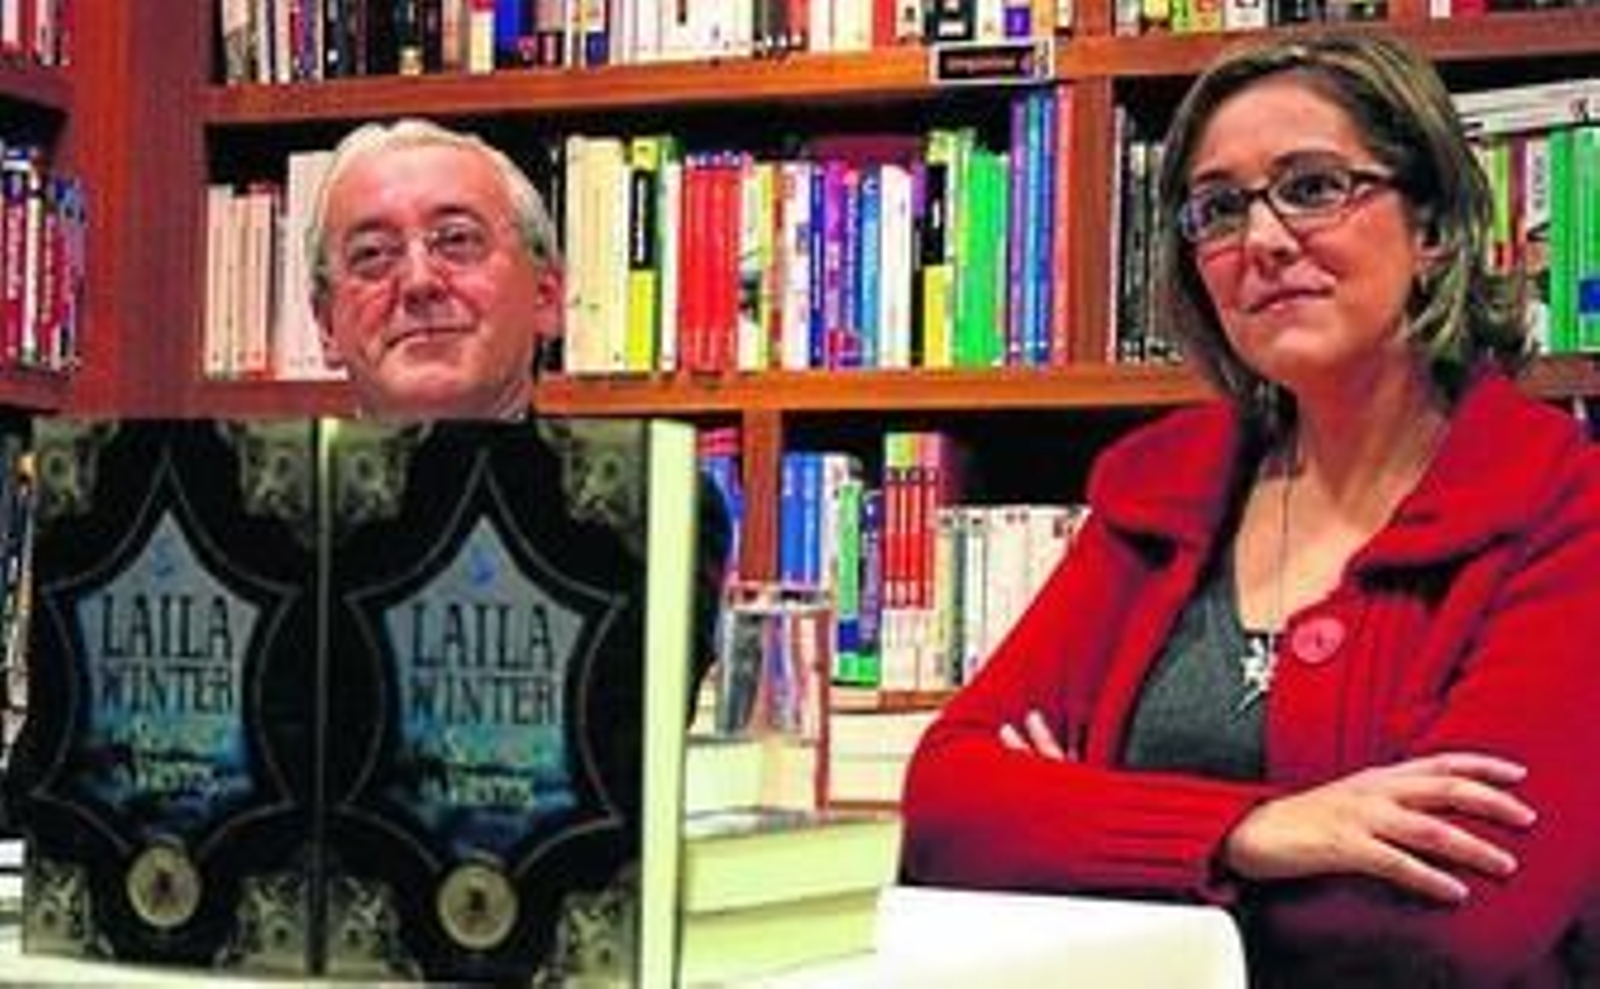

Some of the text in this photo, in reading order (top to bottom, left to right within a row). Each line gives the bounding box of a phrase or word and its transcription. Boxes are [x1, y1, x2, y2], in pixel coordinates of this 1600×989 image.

[102, 594, 233, 657] LAILA
[412, 603, 553, 669] LAILA
[102, 665, 234, 716] WINTER
[410, 675, 557, 727] WINTER
